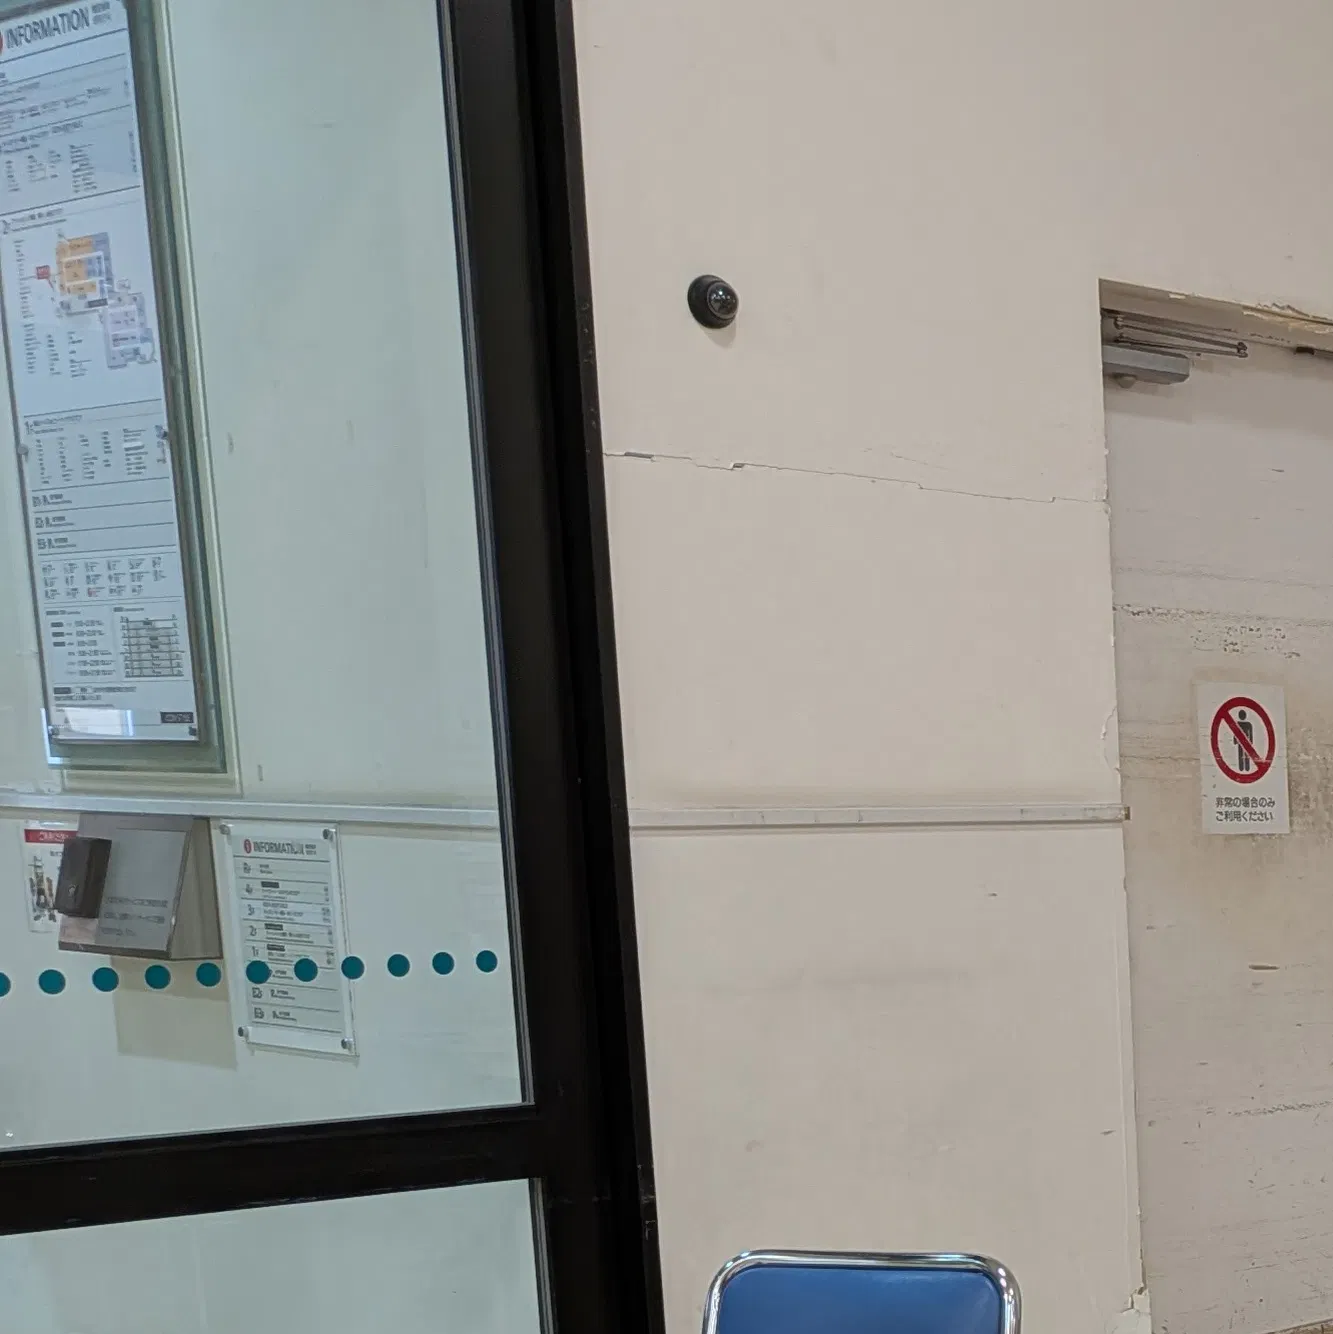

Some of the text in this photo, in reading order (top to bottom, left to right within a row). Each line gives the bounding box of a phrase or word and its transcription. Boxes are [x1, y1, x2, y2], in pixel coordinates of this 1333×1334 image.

[5, 7, 91, 49] INFORMATION
[1216, 797, 1275, 808] 非常の場合のみ
[1216, 811, 1274, 822] ご利用ください
